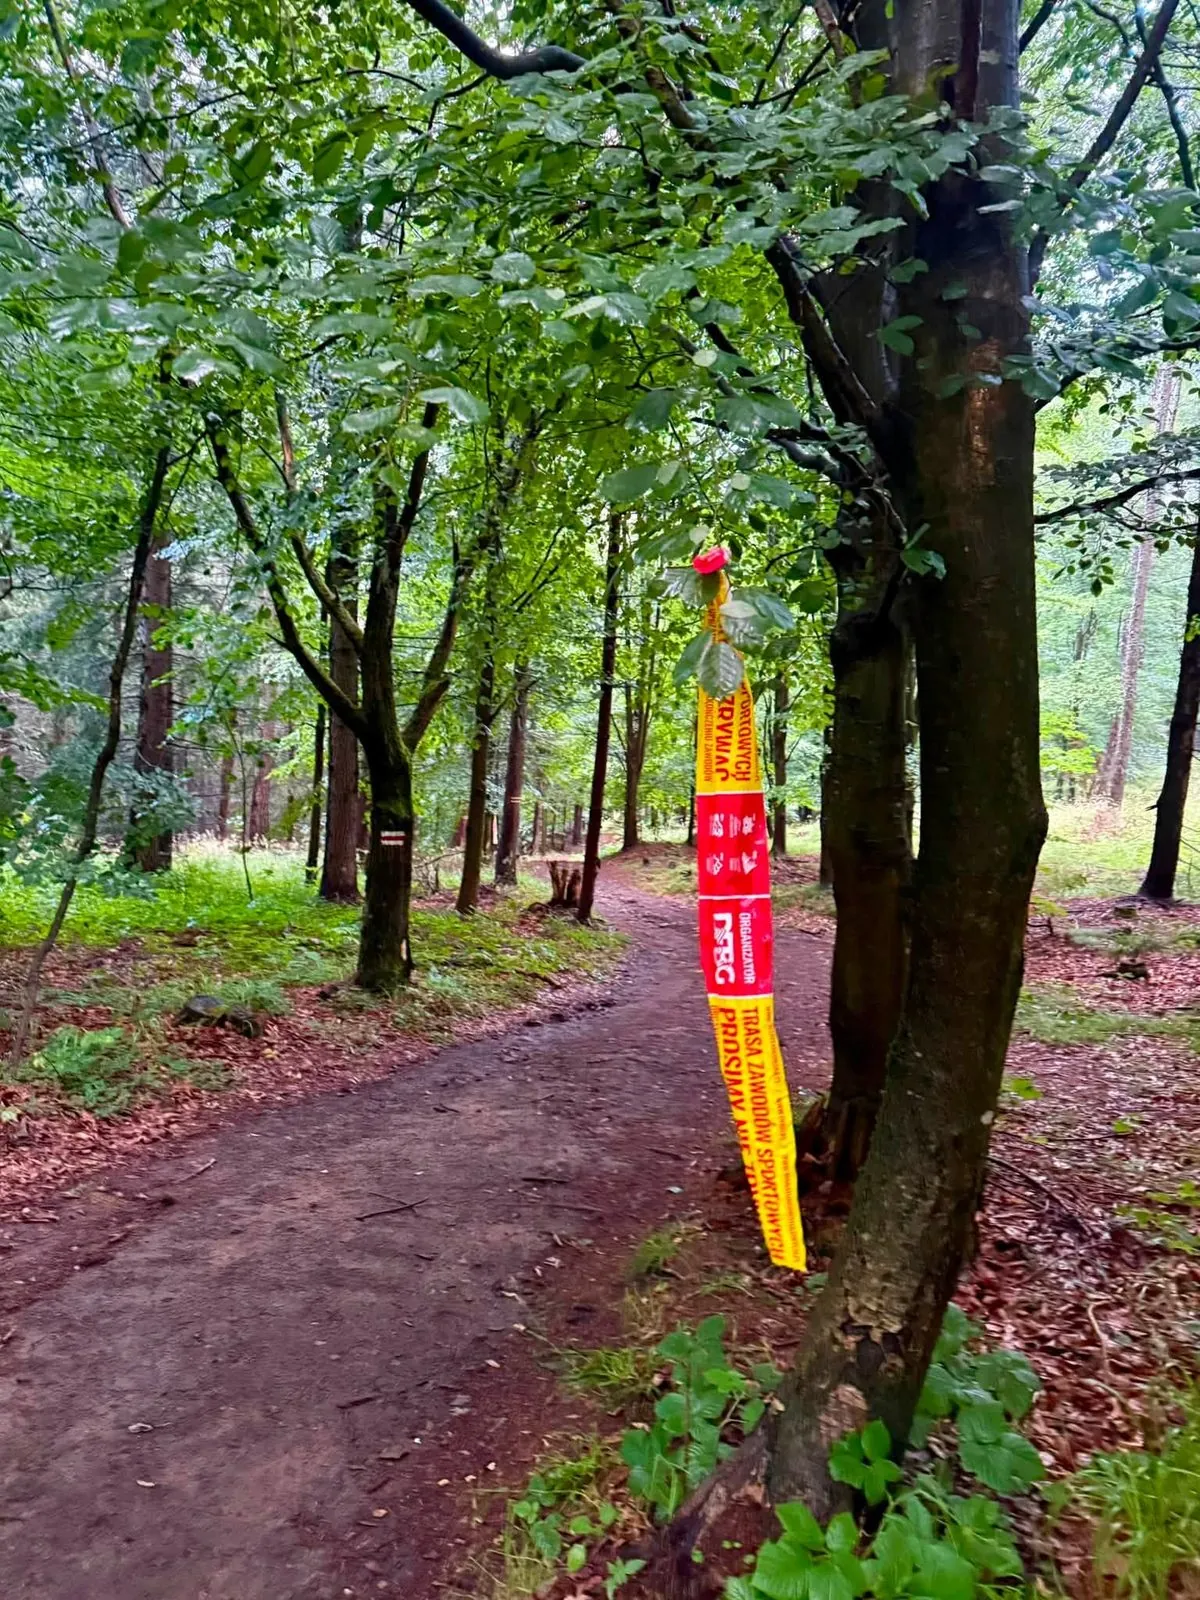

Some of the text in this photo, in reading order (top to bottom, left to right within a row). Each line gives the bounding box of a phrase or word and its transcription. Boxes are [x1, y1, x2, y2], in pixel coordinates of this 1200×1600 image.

[739, 912, 756, 985] ORGANIZATOR
[742, 1006, 763, 1057] TRASA
[747, 1062, 775, 1143] ZAWODÓW
[757, 1149, 784, 1260] SPORTOWYCH
